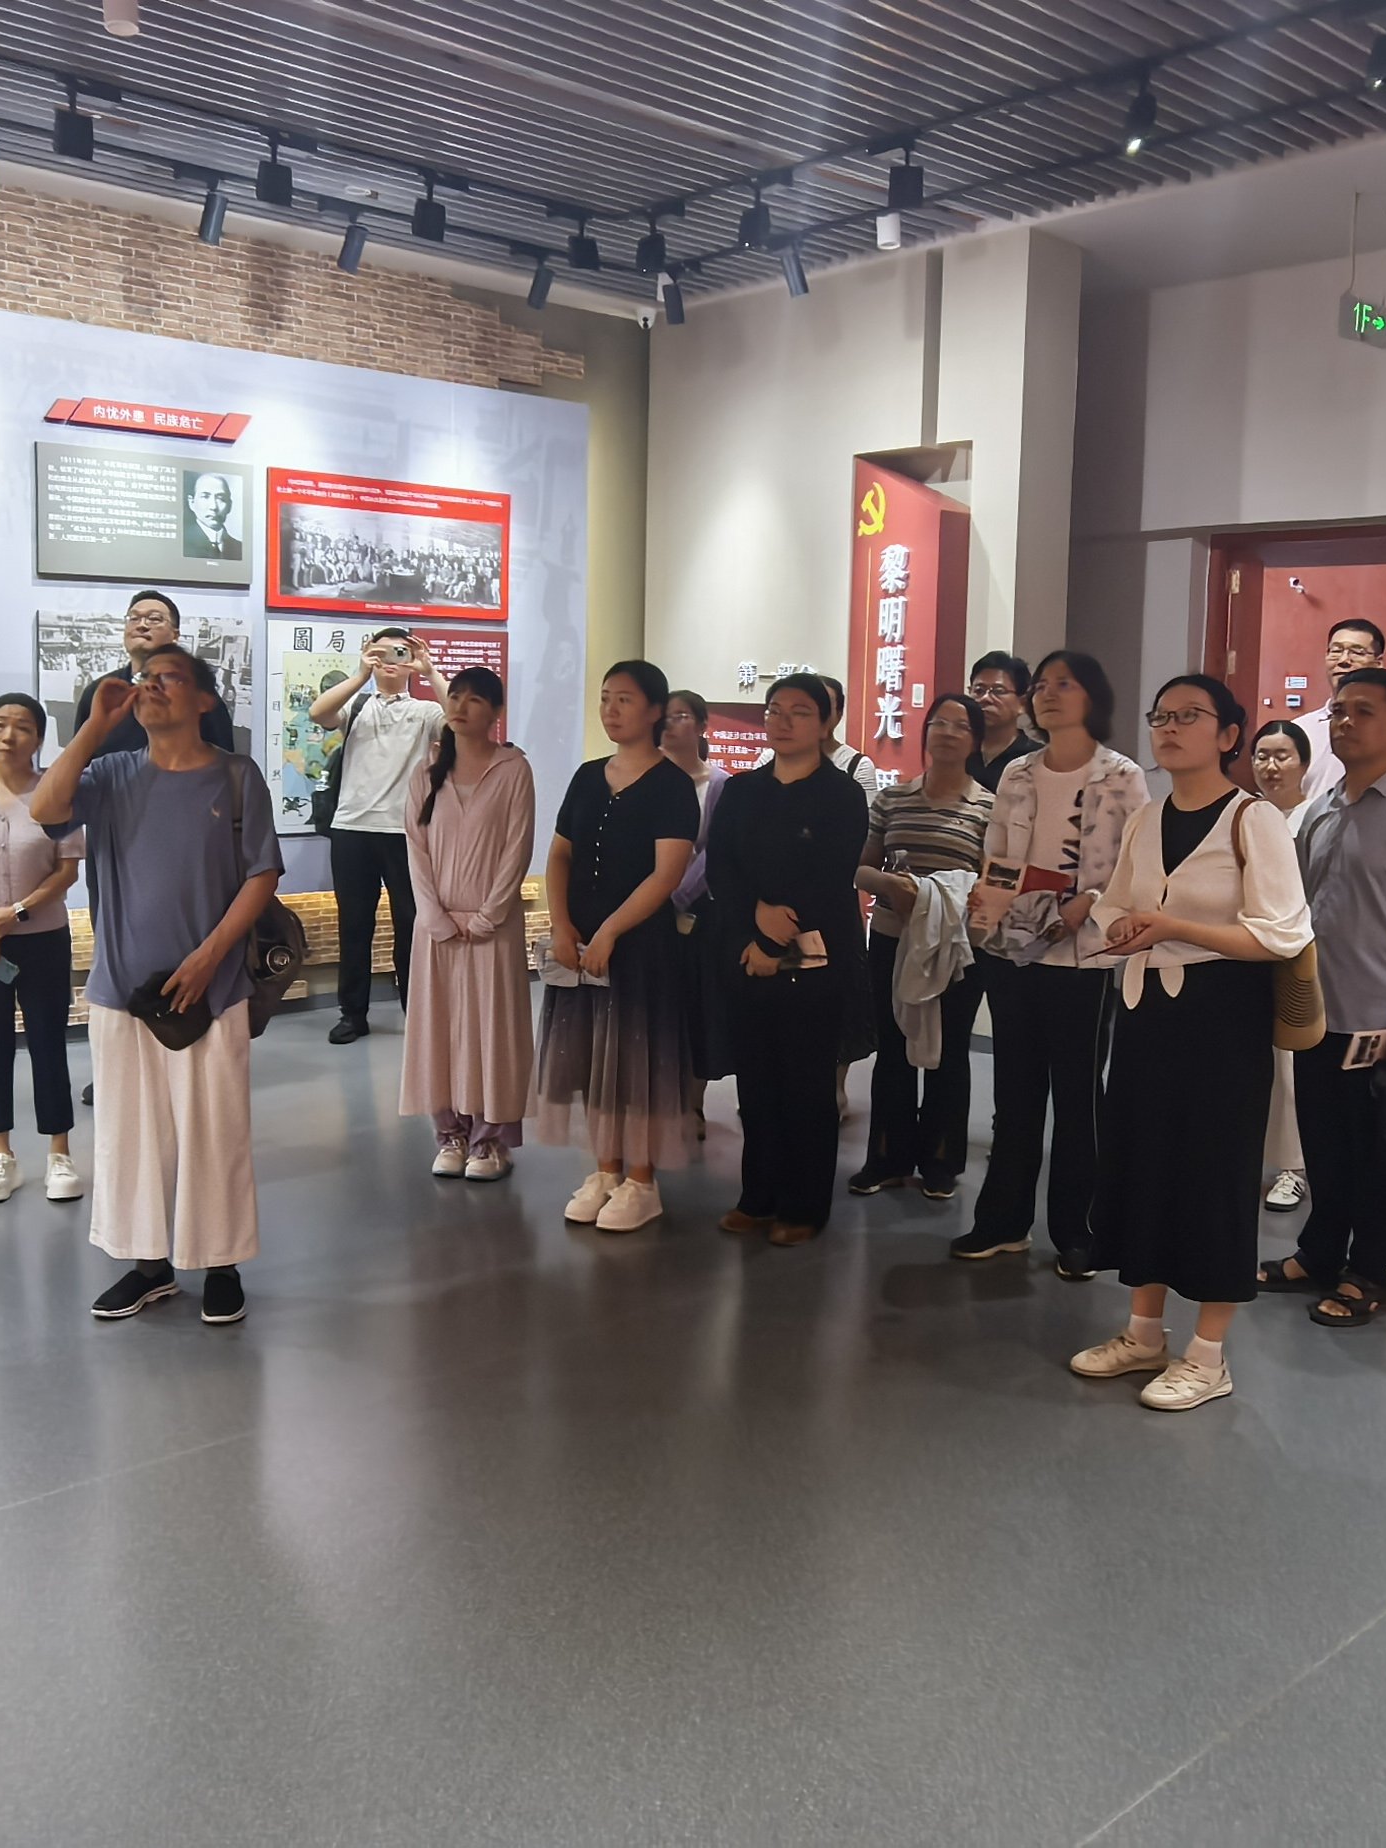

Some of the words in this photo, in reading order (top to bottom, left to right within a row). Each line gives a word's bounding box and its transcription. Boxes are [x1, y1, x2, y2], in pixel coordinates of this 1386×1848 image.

[1353, 302, 1373, 333] 1F
[92, 404, 146, 423] 内忧外患
[153, 412, 204, 430] 民族危亡
[873, 543, 910, 739] 黎明曙光
